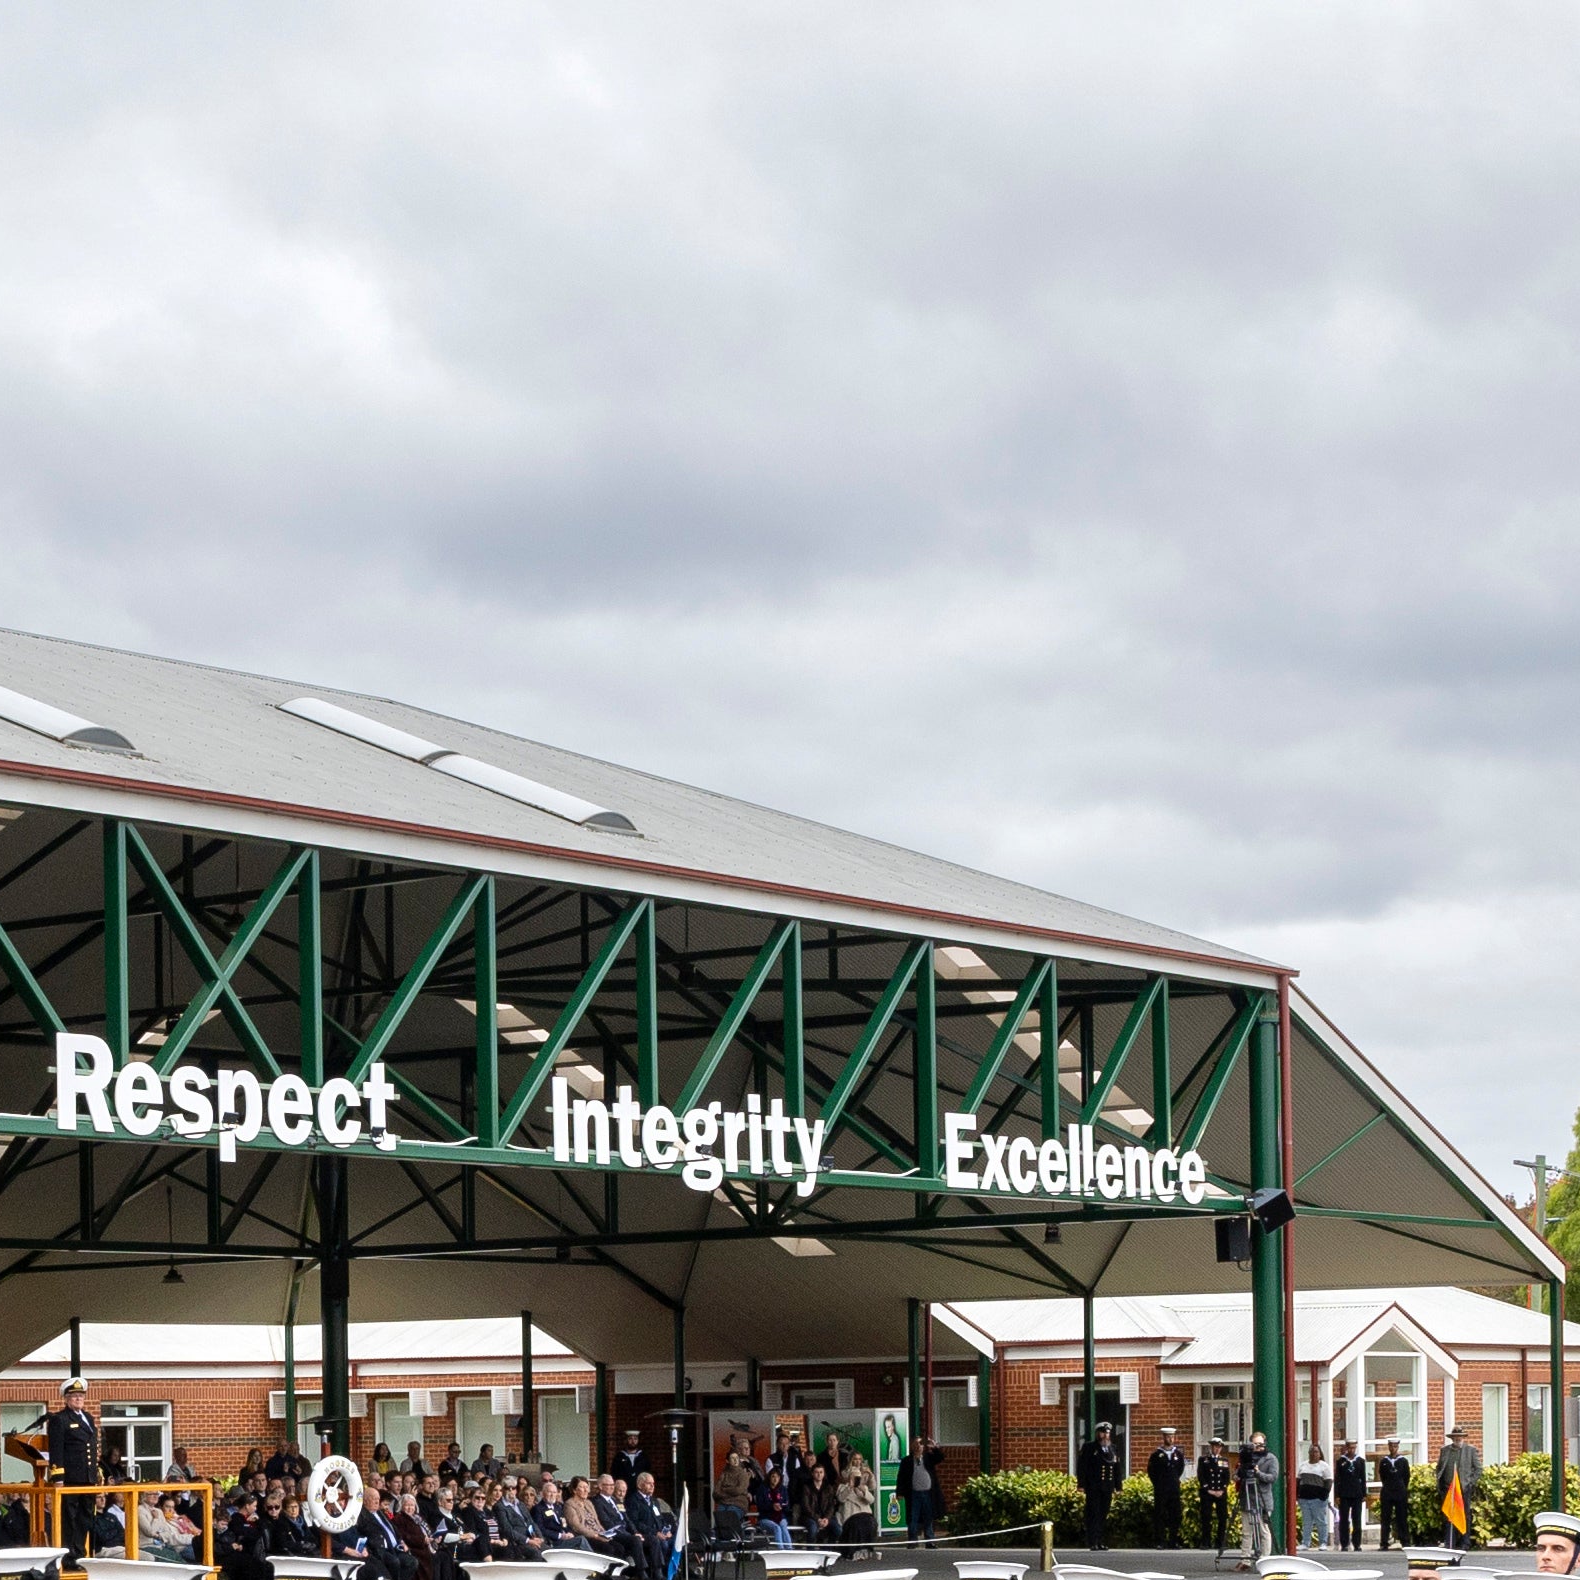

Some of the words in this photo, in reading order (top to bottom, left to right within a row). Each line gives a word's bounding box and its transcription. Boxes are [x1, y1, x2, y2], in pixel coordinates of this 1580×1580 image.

[56, 1031, 398, 1163] Respect
[551, 1076, 826, 1198] Integrity
[943, 1111, 1206, 1205] Excellence
